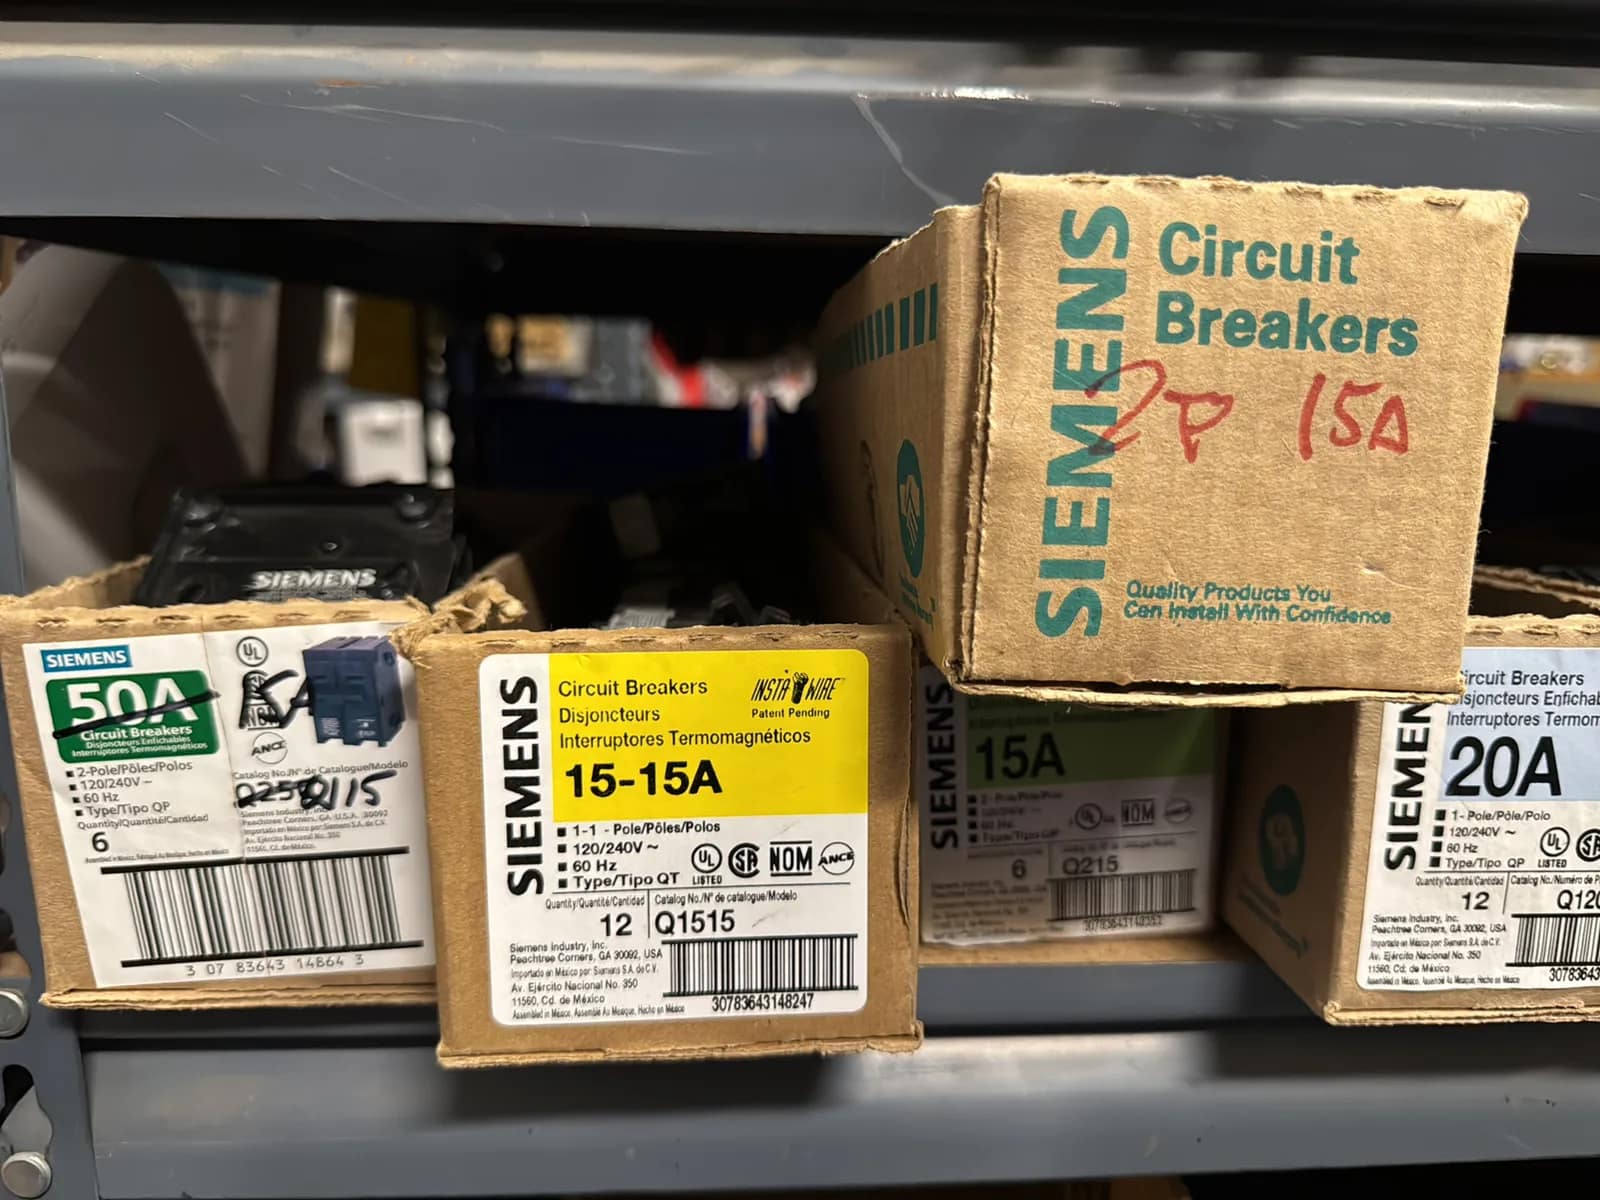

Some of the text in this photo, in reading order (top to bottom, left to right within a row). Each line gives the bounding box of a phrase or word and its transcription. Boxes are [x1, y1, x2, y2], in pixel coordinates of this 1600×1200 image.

[1159, 221, 1360, 284] Circuit
[1155, 290, 1419, 356] Breakers
[1084, 359, 1409, 464] 2P 15A
[1034, 204, 1129, 637] SIEMENS
[253, 569, 377, 590] SIEMENS
[1126, 580, 1331, 602] Quality Products You
[1124, 600, 1391, 624] Can Install With Confidence
[46, 650, 127, 668] SIEMENS
[1460, 670, 1585, 686] ircuit Breakers
[558, 678, 708, 698] Circuit Breakers
[66, 678, 199, 726] 50A
[559, 706, 661, 728] Disjoncteurs
[751, 707, 831, 720] Patent Pending
[1446, 711, 1541, 729] Interruptores
[80, 725, 193, 742] Circuit Breakers
[559, 727, 812, 752] Interruptores Termomagnéticos
[72, 747, 130, 758] Interruptores
[86, 739, 141, 750] Disjoncteurs
[975, 731, 1066, 781] 15A
[233, 768, 271, 780] Catalog
[925, 682, 959, 850] SIEMENS
[1444, 736, 1562, 798] 20A
[80, 777, 140, 790] 120/240V
[499, 674, 544, 897] SIEMENS
[564, 759, 723, 799] 15-15A
[83, 791, 119, 804] 60 Hz
[87, 801, 170, 818] Type/Tipo QP
[1467, 809, 1551, 821] Pole/Pôle/Polo
[572, 824, 597, 837] 1-1
[613, 821, 721, 836] Pole/Pôles/Polos
[1449, 827, 1500, 838] 120/240V
[91, 831, 110, 852] 6
[573, 840, 643, 856] 120/240V
[1446, 843, 1478, 854] 60 Hz
[572, 858, 618, 873] 60 Hz
[769, 846, 813, 873] NOM
[818, 851, 855, 867] ANCE
[1061, 855, 1119, 876] Q215
[1446, 858, 1526, 869] Type/Tipo QP
[1537, 859, 1567, 868] LISTED
[1011, 858, 1027, 879] 6
[572, 871, 681, 892] Type/Tipo QT
[692, 875, 722, 886] LISTED
[1510, 875, 1539, 887] Catalog
[1583, 874, 1593, 884] de
[654, 894, 686, 906] Catalog
[715, 892, 725, 902] de
[727, 890, 798, 904] catalogue/Modelo
[1461, 891, 1490, 910] 12
[600, 912, 633, 938] 12
[654, 908, 736, 936] Q1515
[1373, 914, 1407, 923] Siemens
[1445, 913, 1459, 923] Inc.
[1449, 924, 1461, 933] GA
[1489, 924, 1507, 933] USA
[510, 940, 608, 953] Siemens Industry, Inc.
[1415, 951, 1450, 960] Nacional
[1451, 951, 1464, 960] No.
[1466, 950, 1481, 960] 350
[510, 953, 556, 964] Peachtree
[600, 951, 612, 961] GA
[643, 948, 663, 959] USA
[186, 954, 365, 977] 3 07 83643 14864 3
[1409, 965, 1419, 974] de
[1421, 963, 1450, 974] México
[528, 981, 562, 994] Ejército
[564, 980, 603, 992] Nacional
[622, 978, 639, 989] 350
[560, 994, 571, 1004] de
[573, 992, 605, 1004] México
[711, 992, 815, 1012] 30783643148247
